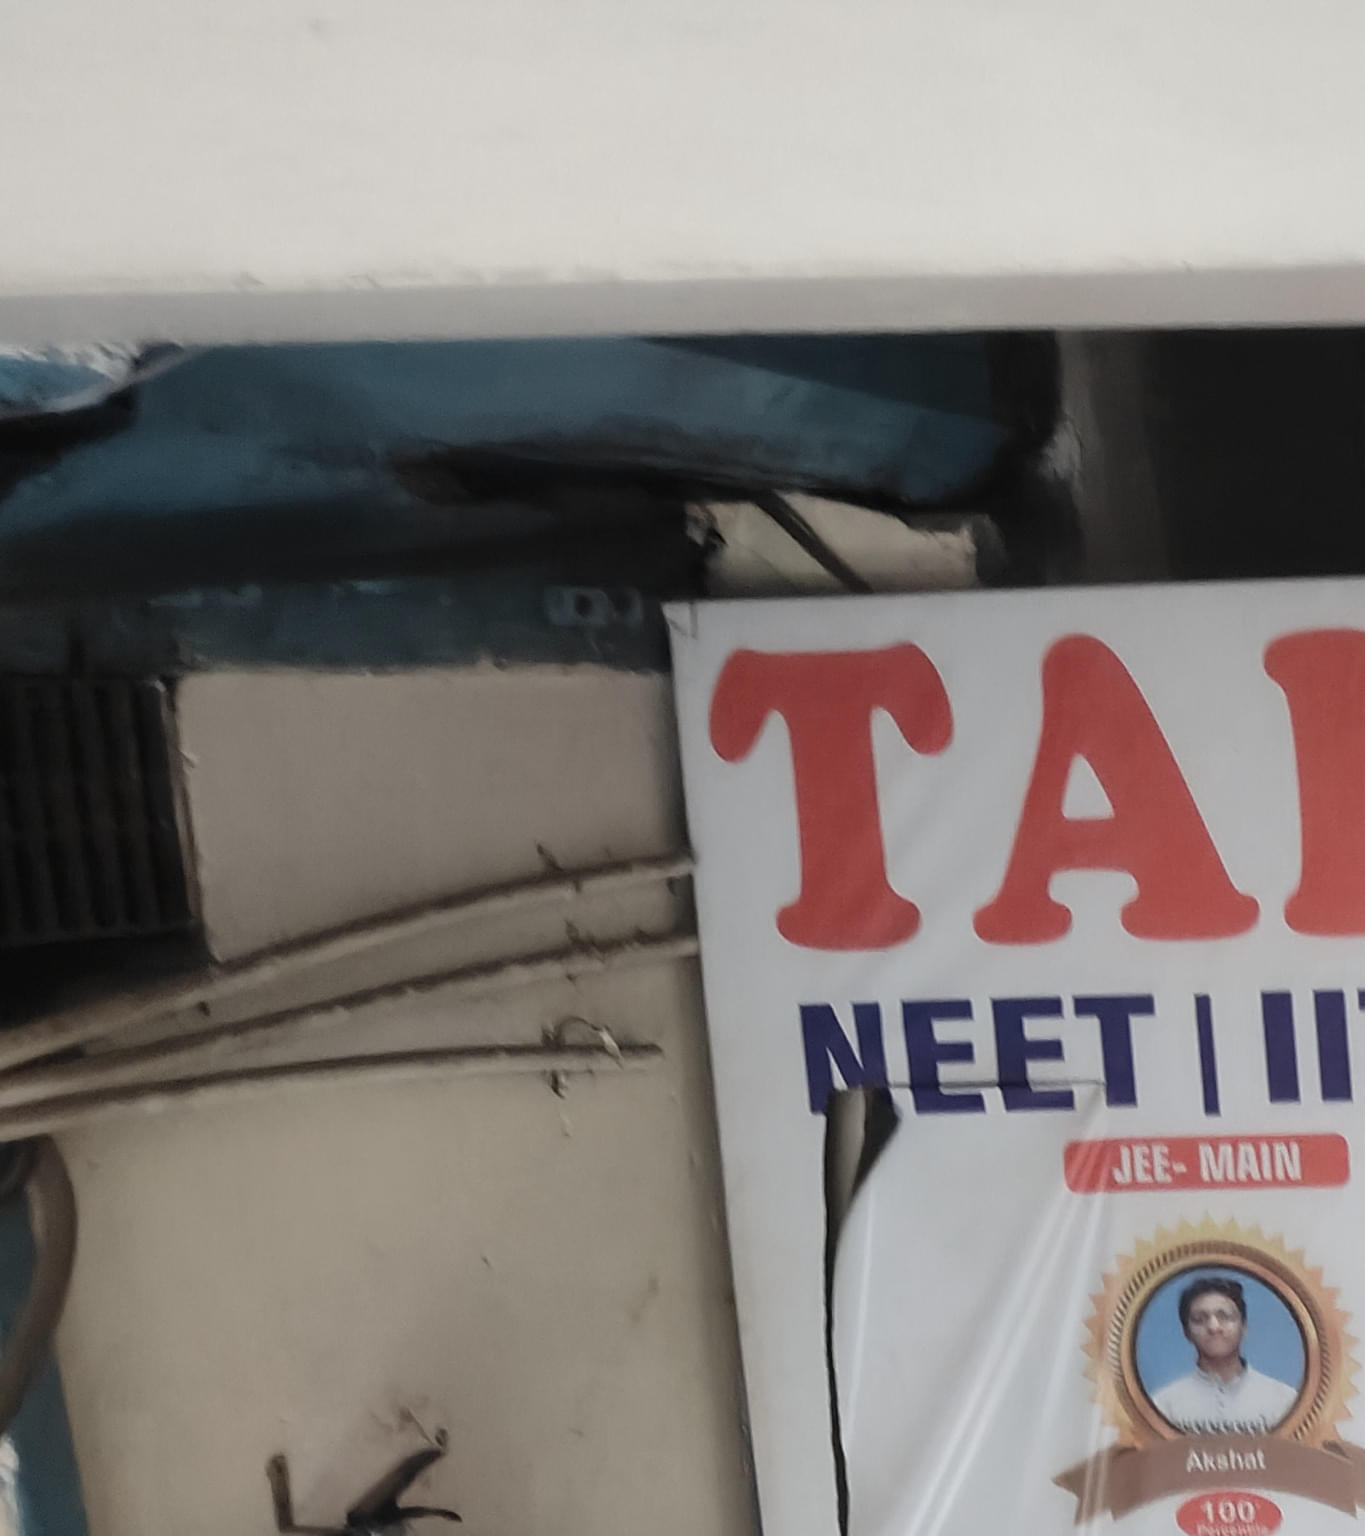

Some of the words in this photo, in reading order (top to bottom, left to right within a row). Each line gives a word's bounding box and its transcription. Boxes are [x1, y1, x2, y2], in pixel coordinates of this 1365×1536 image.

[799, 993, 1155, 1116] NEET
[1199, 1142, 1302, 1181] MAIN
[1187, 1449, 1265, 1472] Akshat
[1205, 1501, 1254, 1523] 100
